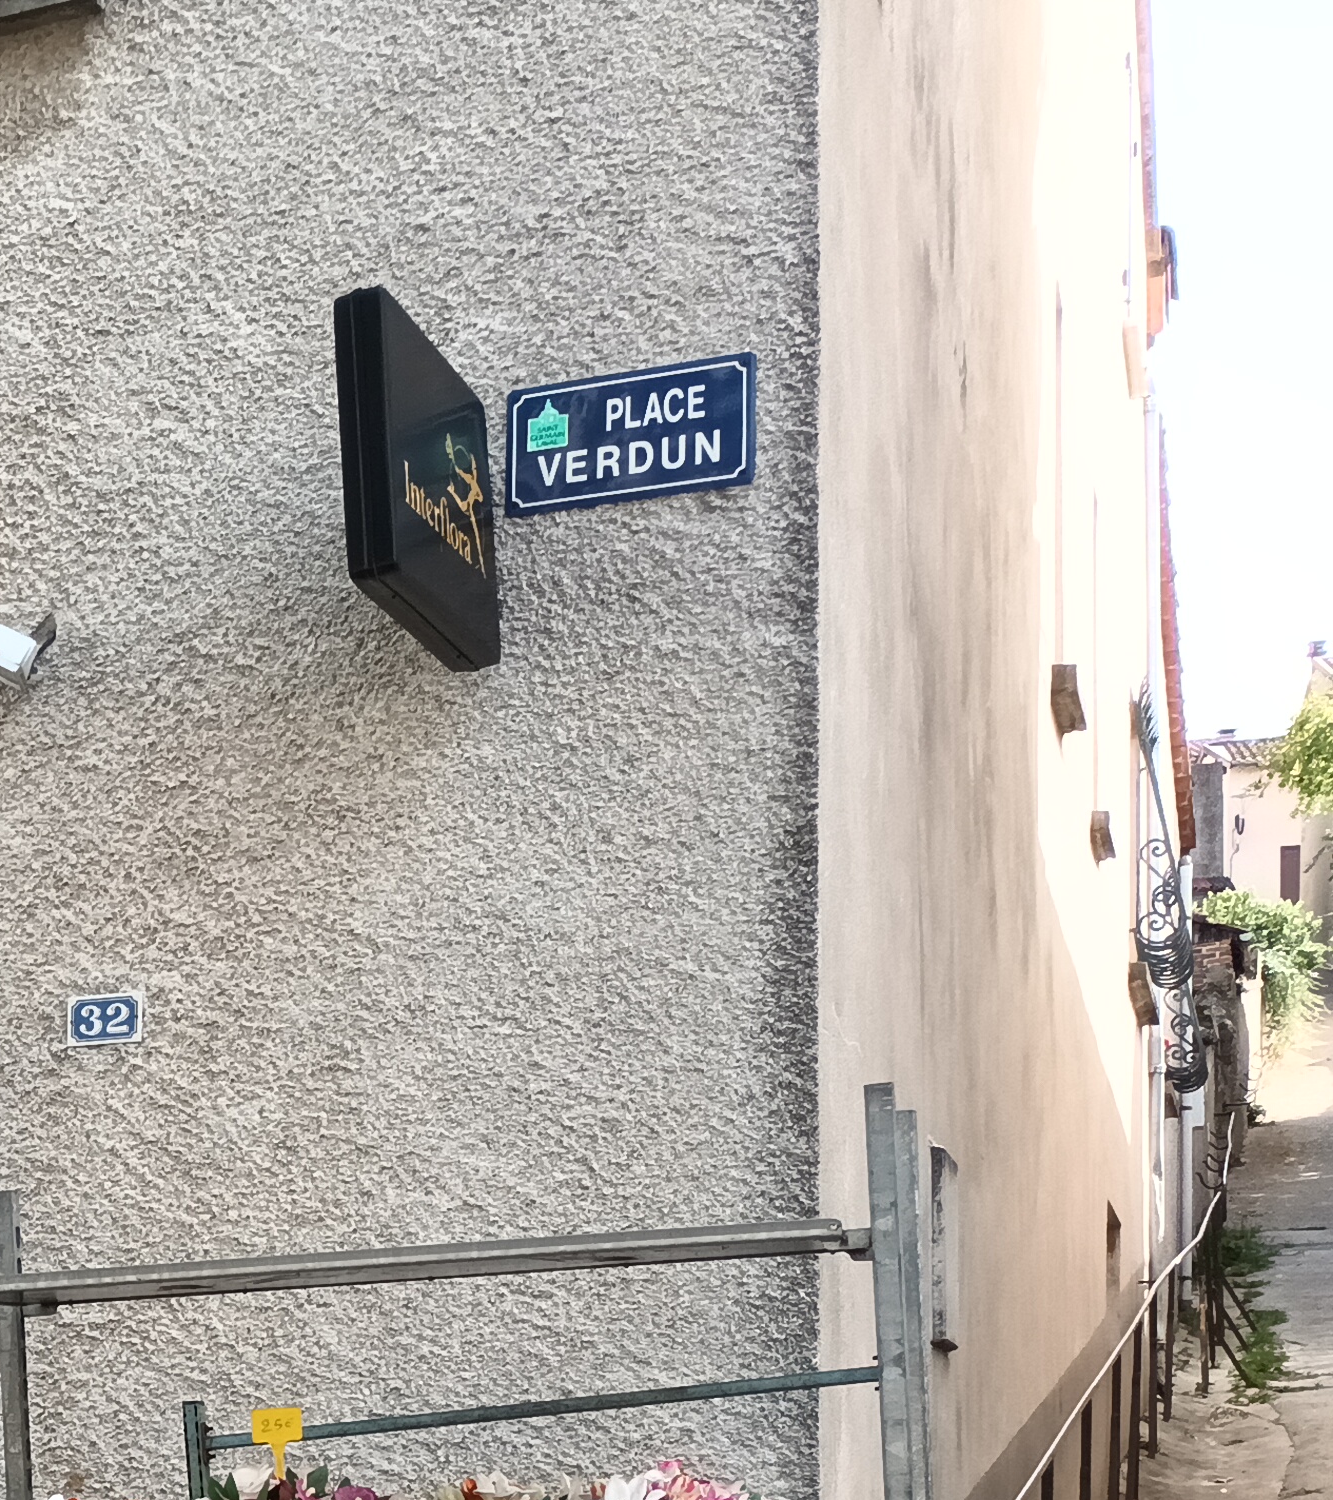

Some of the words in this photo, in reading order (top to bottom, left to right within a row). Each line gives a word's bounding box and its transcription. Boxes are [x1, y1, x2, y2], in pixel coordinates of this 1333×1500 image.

[605, 385, 706, 431] PLACE
[537, 429, 721, 487] VERDUN
[404, 460, 473, 564] Interflora
[79, 1002, 131, 1036] 32
